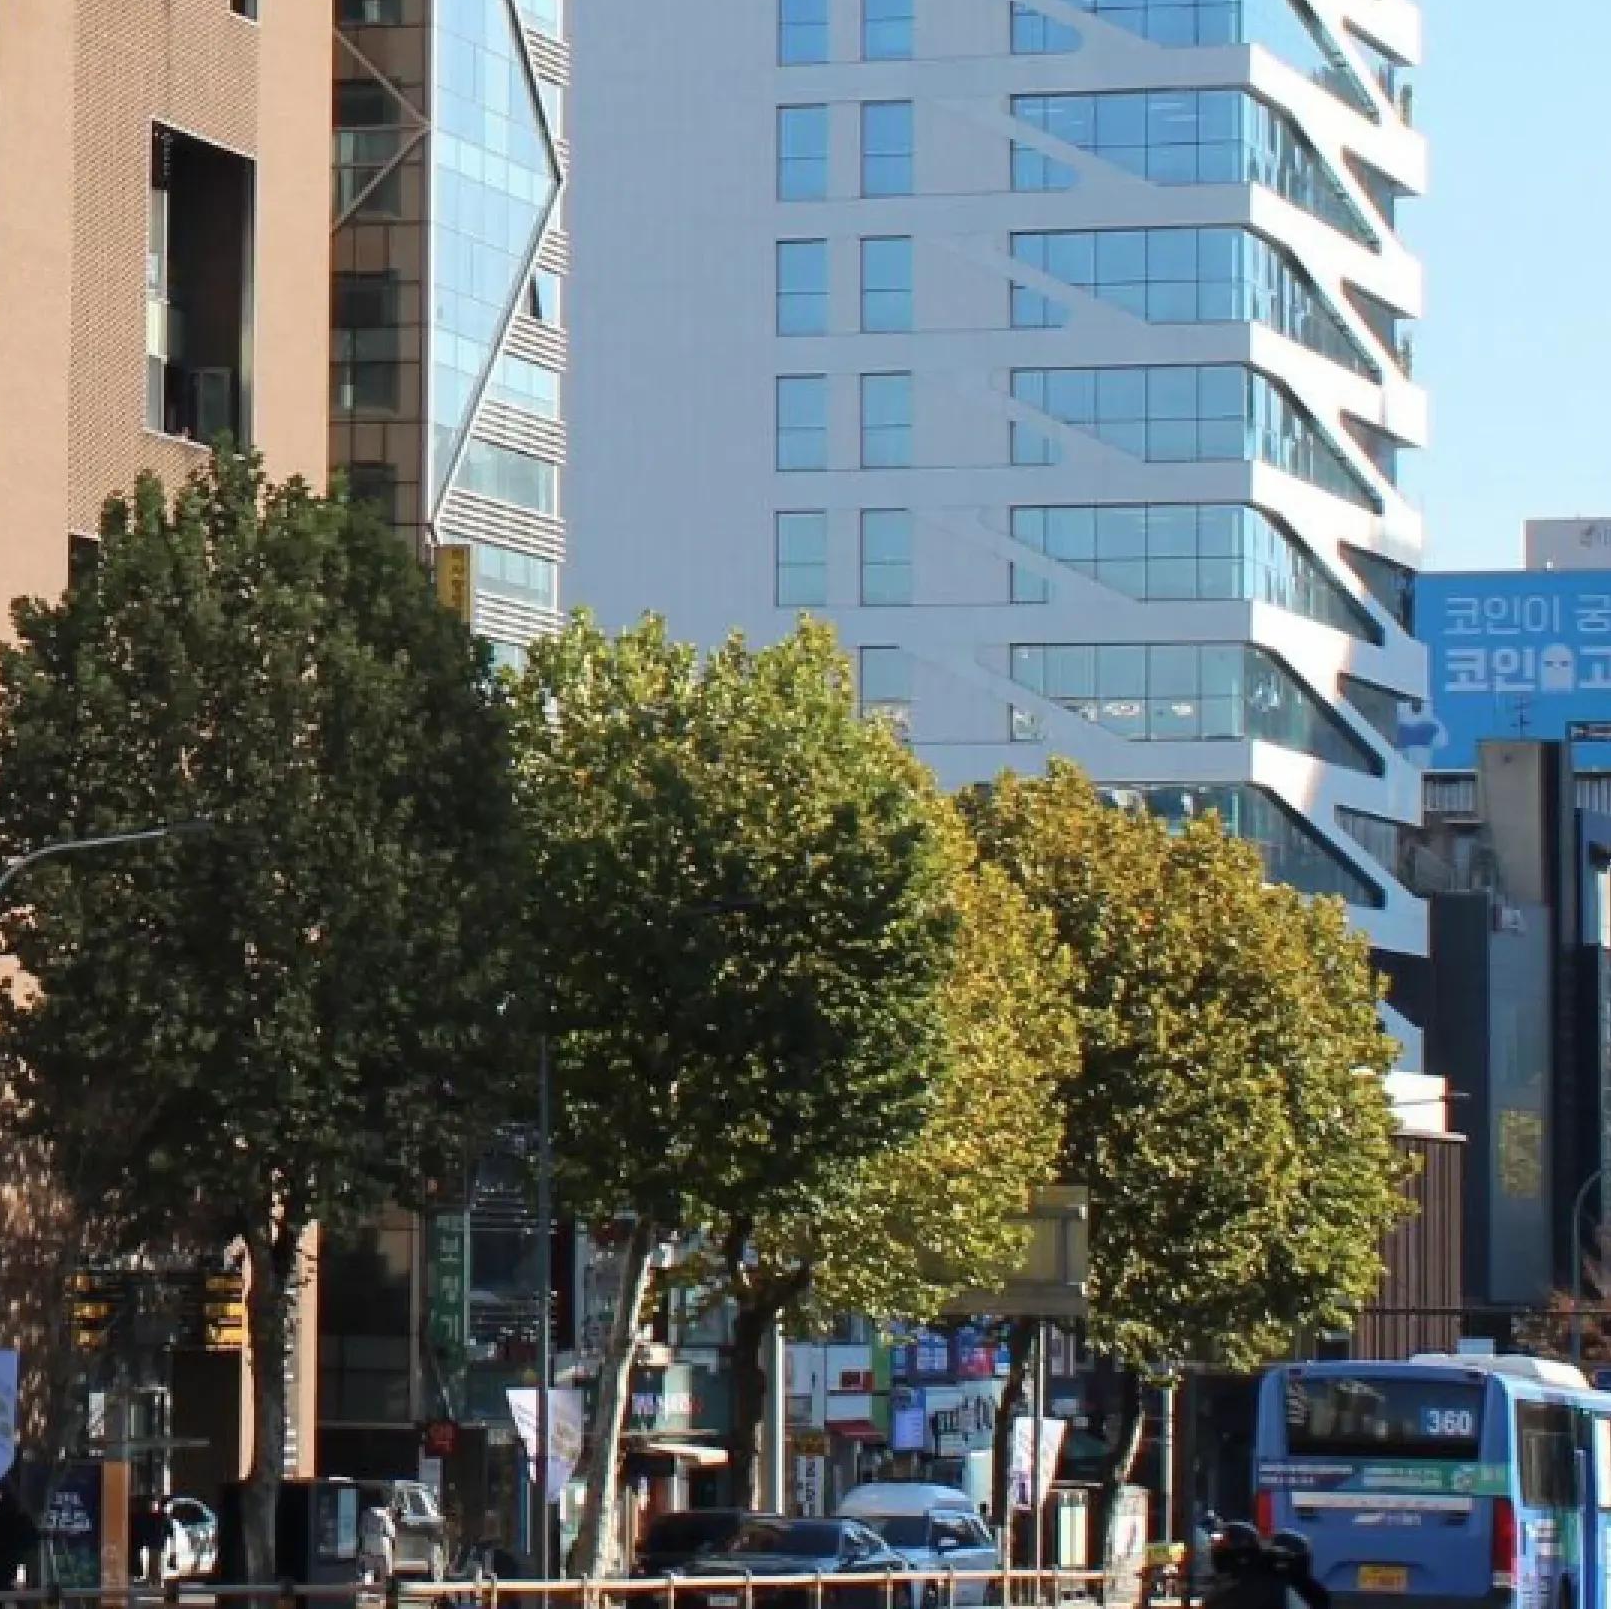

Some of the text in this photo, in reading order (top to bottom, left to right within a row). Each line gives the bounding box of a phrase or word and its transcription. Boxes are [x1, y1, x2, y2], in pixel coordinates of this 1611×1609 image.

[1443, 594, 1560, 635] 코인이
[1445, 648, 1536, 692] 코인
[1427, 1410, 1473, 1436] 360
